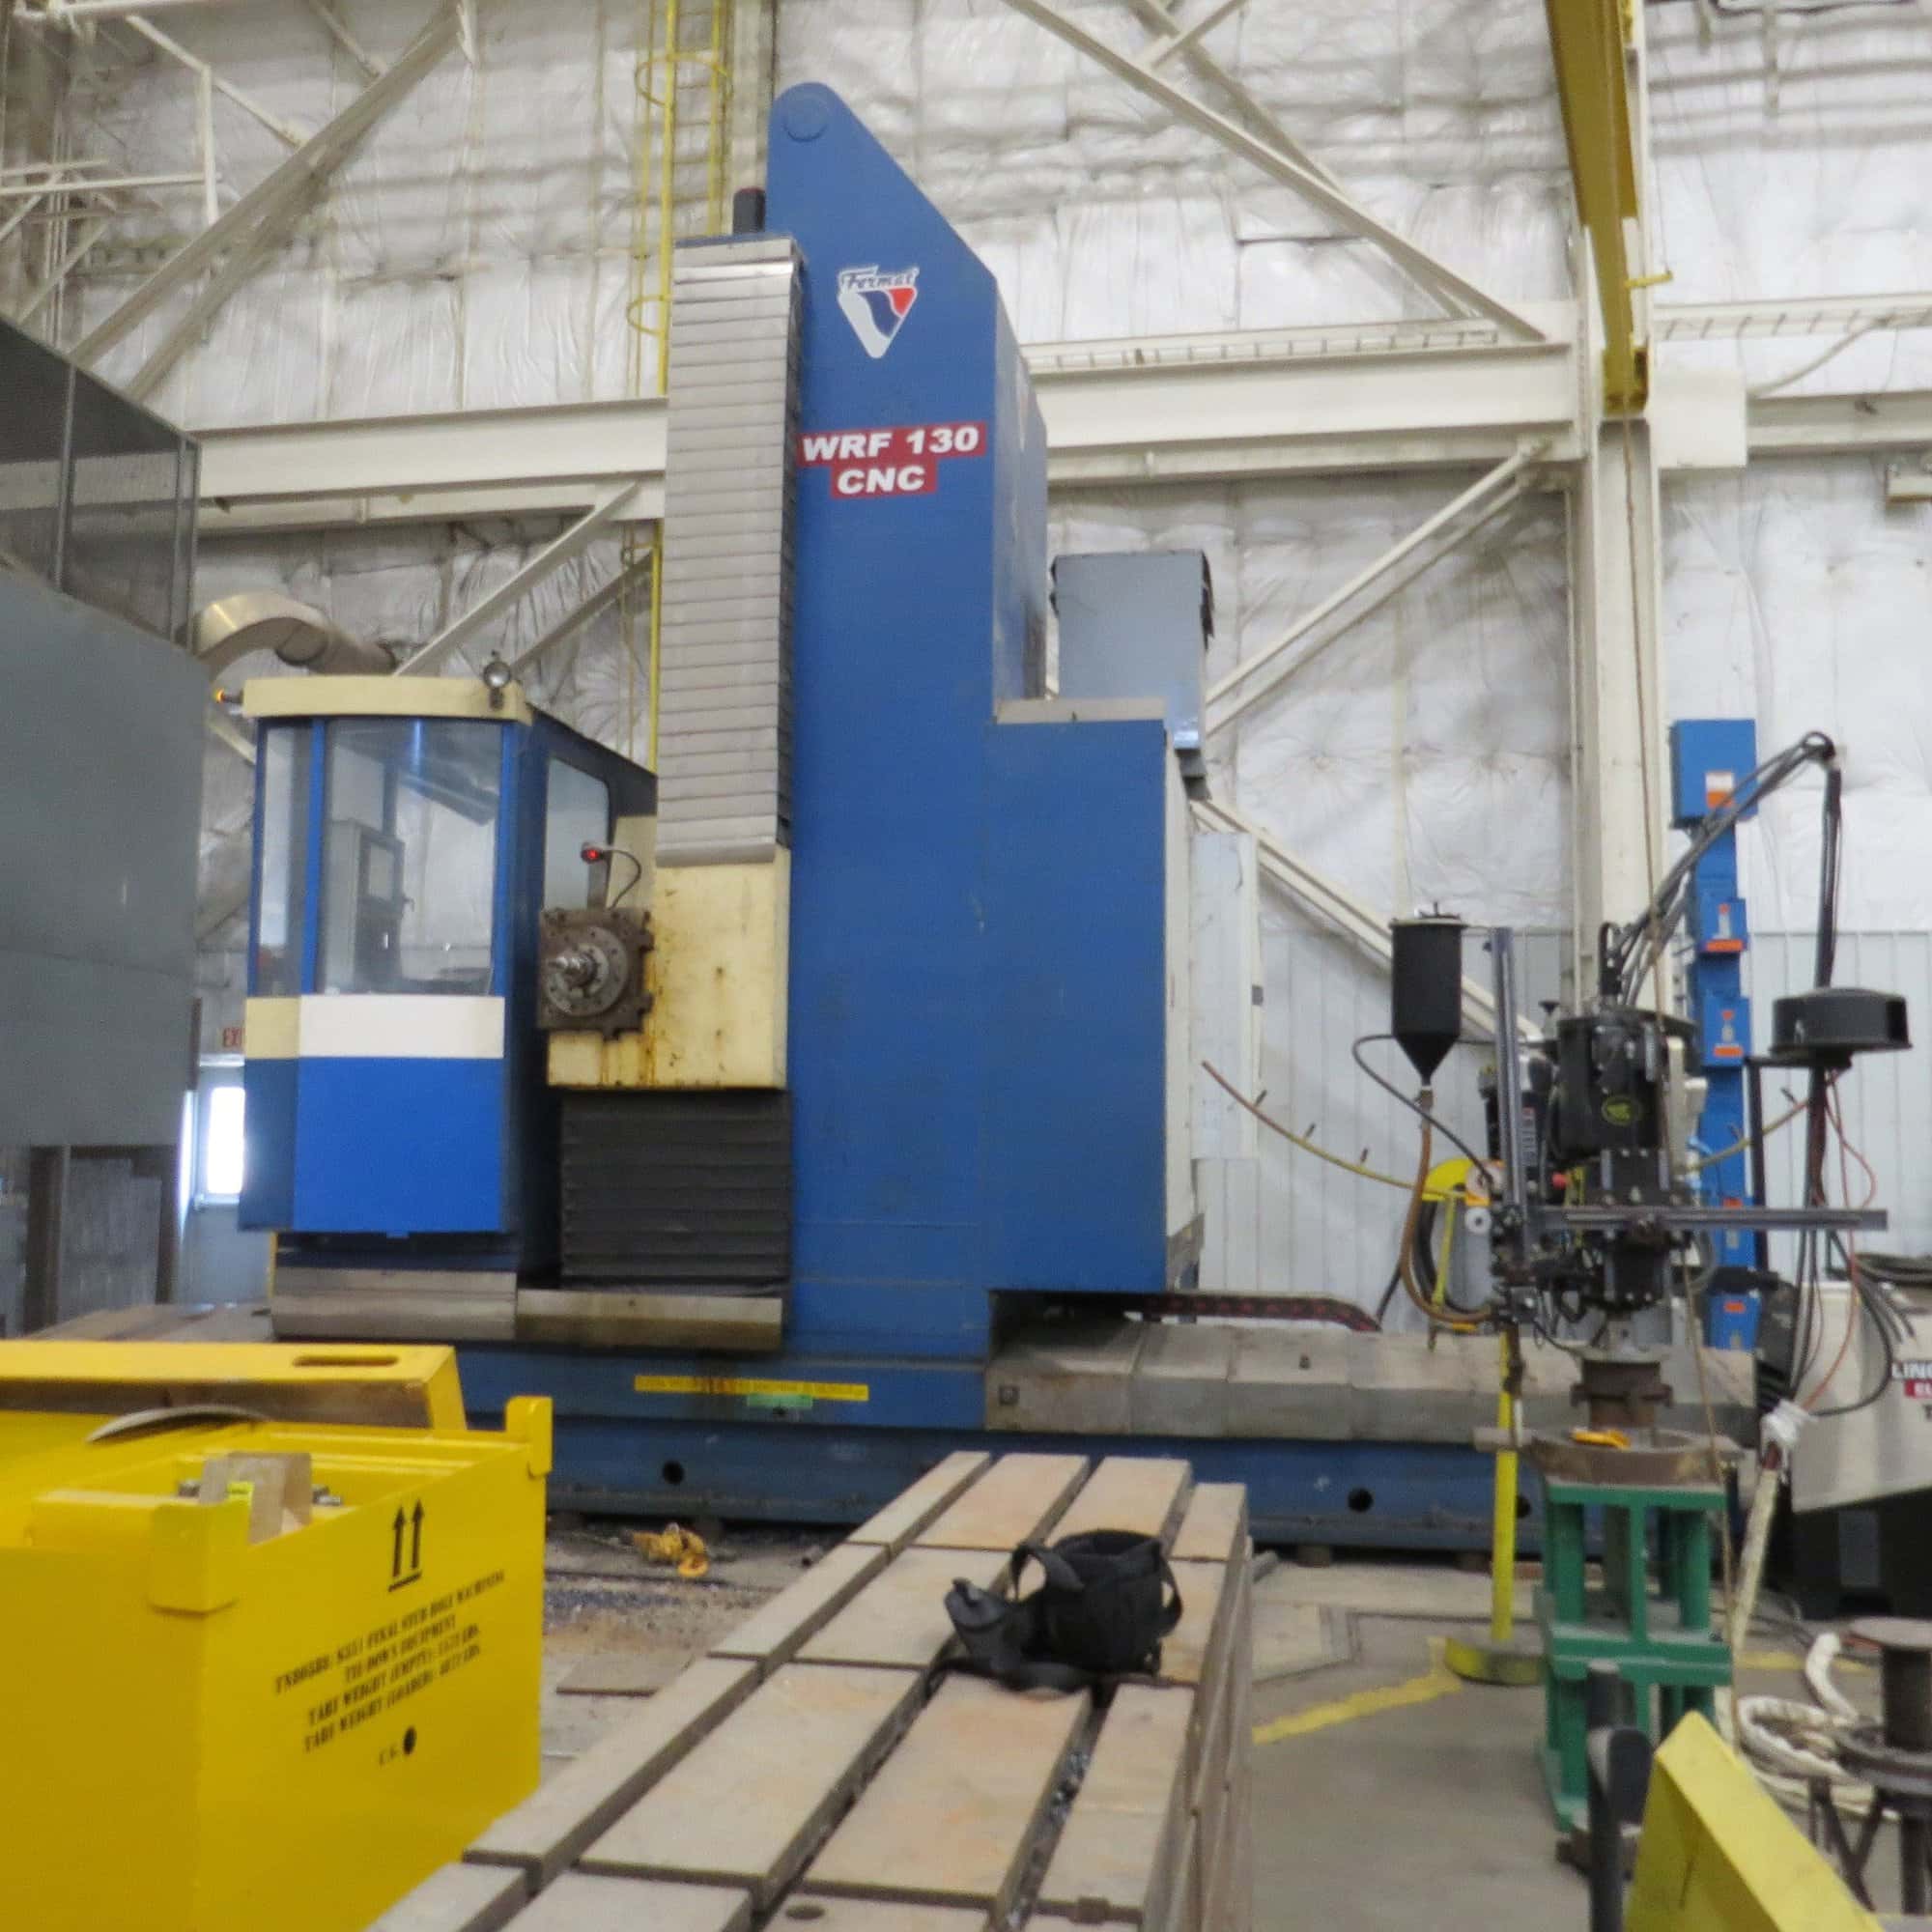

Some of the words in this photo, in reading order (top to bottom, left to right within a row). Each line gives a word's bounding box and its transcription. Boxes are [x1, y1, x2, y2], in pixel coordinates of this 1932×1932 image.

[802, 432, 894, 462] WRF
[905, 426, 980, 455] 130
[837, 465, 925, 495] CNC
